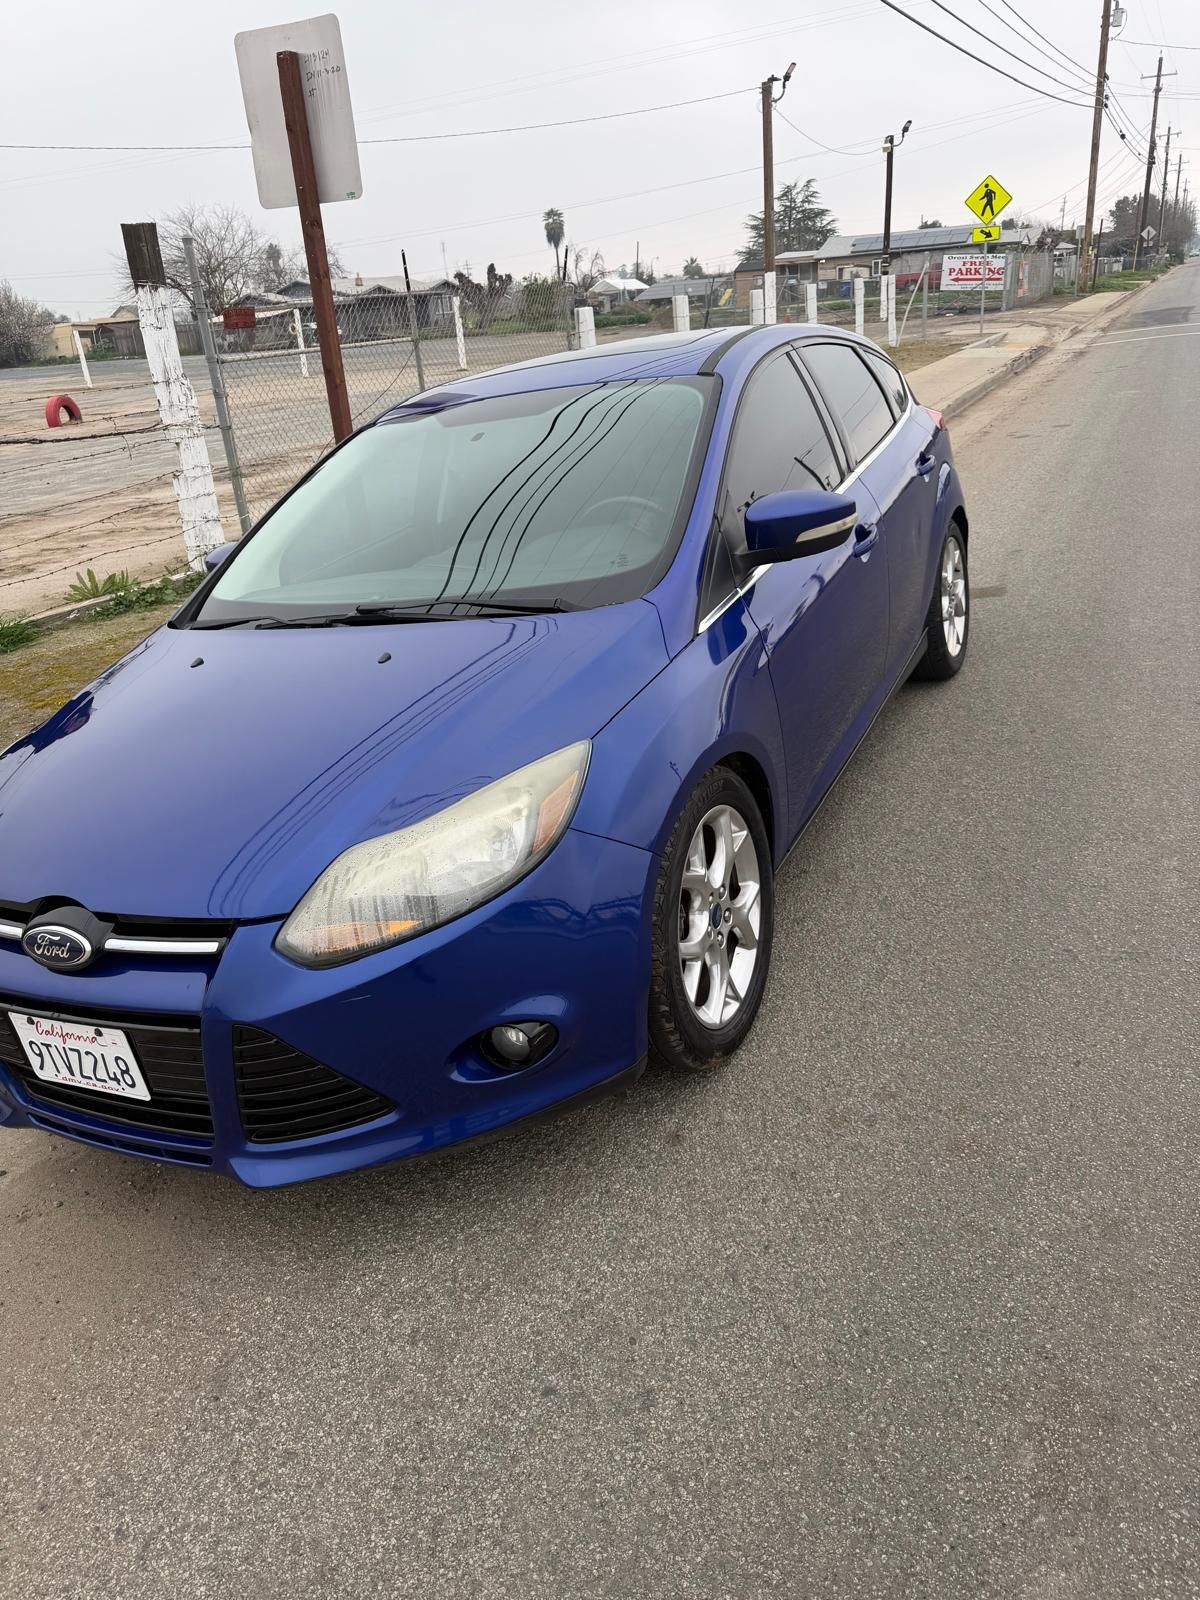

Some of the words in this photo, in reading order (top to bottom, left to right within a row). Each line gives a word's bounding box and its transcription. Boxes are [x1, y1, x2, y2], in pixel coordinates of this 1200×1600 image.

[948, 267, 1005, 276] PARKNG
[34, 933, 70, 959] Ford
[35, 1020, 98, 1045] California
[28, 1040, 136, 1089] 9TVZ248
[62, 1076, 120, 1092] dmv.ca.gov
